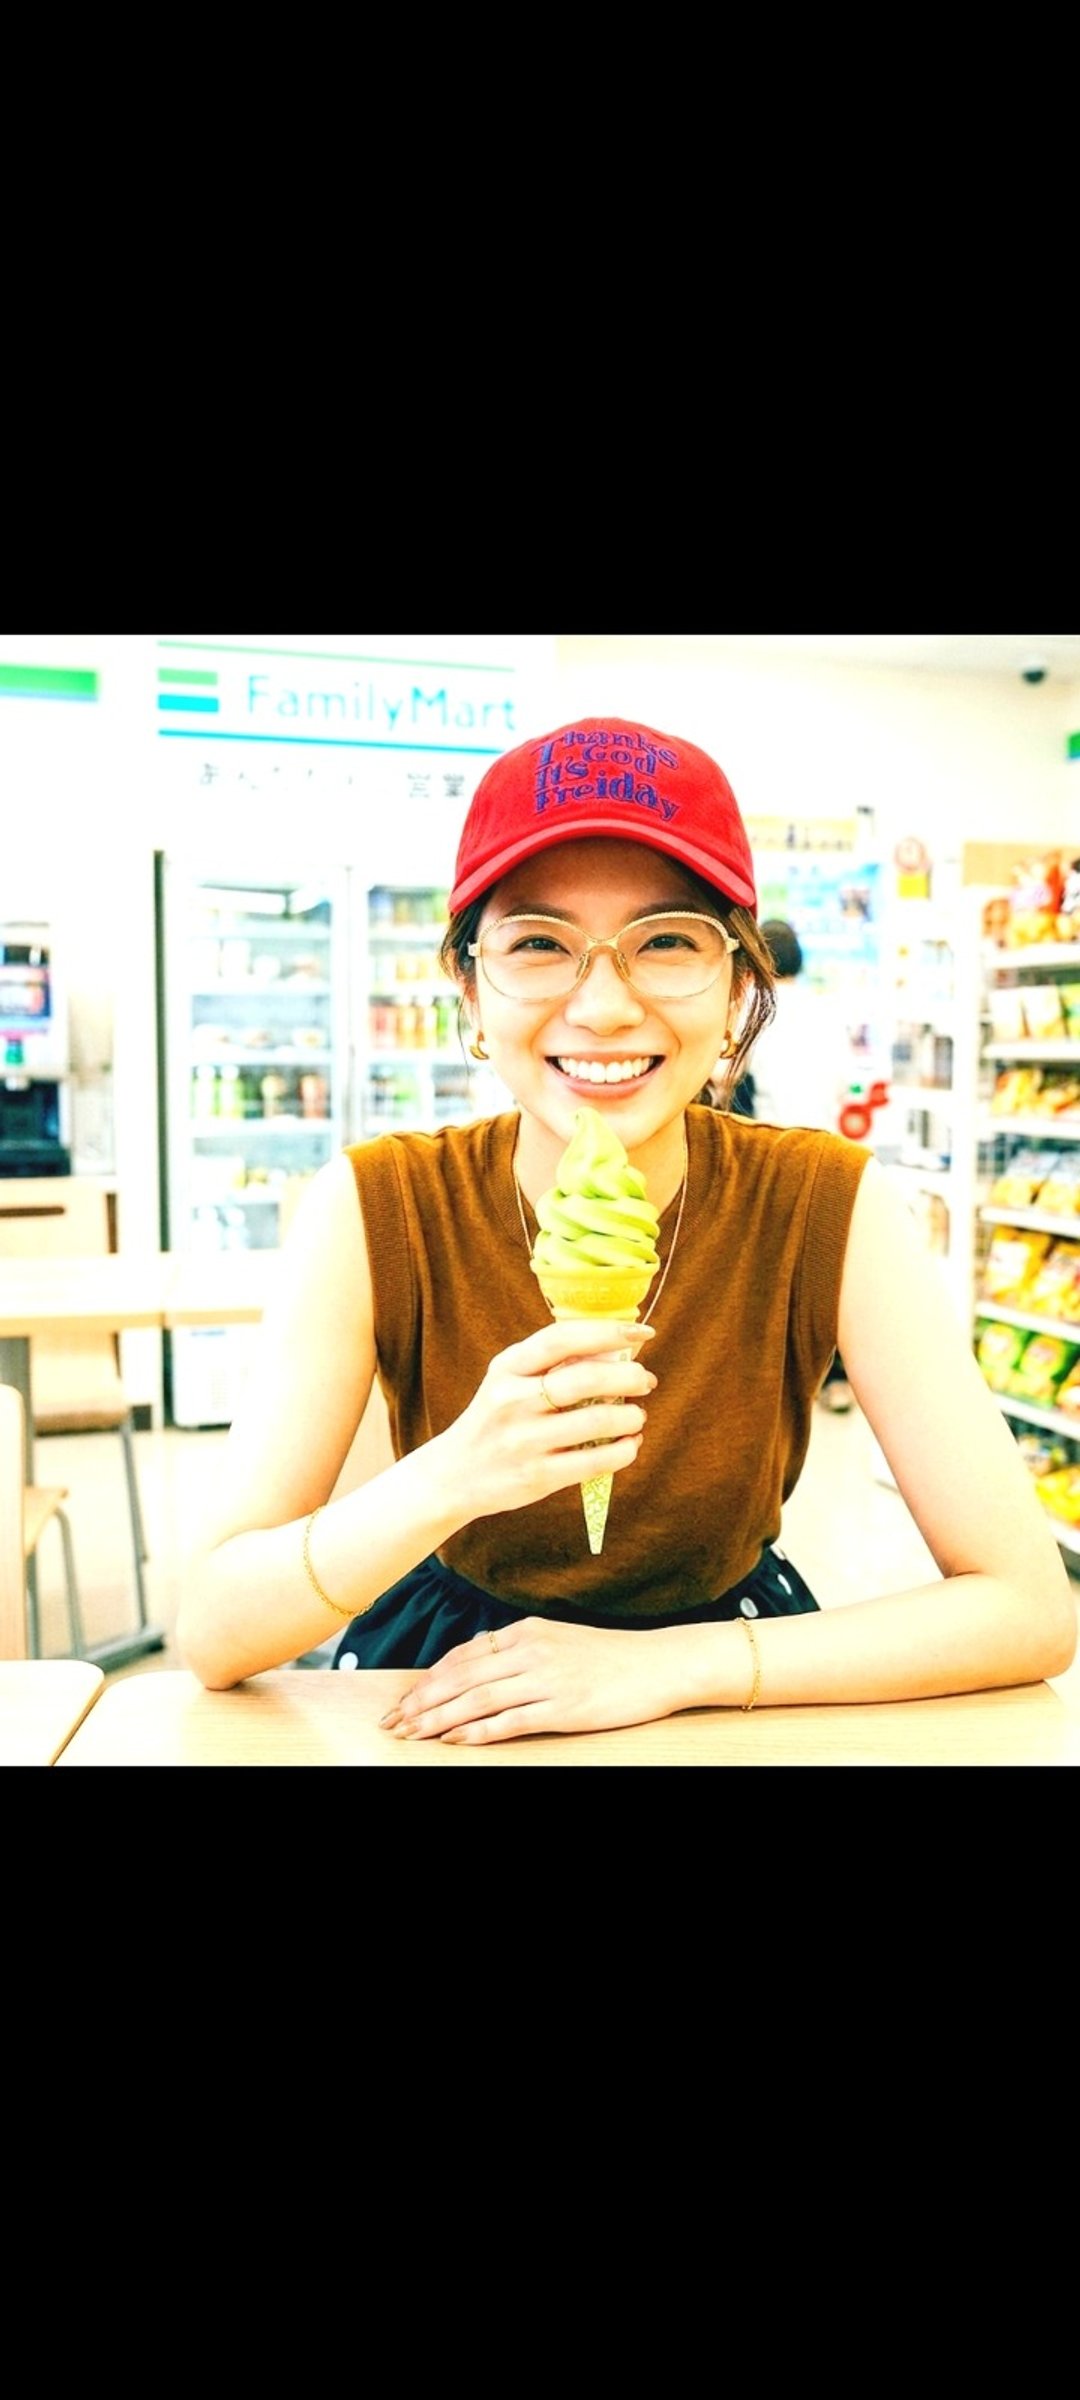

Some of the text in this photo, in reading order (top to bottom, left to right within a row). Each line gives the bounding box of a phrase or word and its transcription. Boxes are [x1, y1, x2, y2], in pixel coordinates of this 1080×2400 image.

[247, 673, 517, 731] FamilyMart
[531, 731, 679, 770] Thanks
[582, 745, 657, 776] God
[535, 756, 589, 791] It's
[534, 770, 680, 821] Freiday
